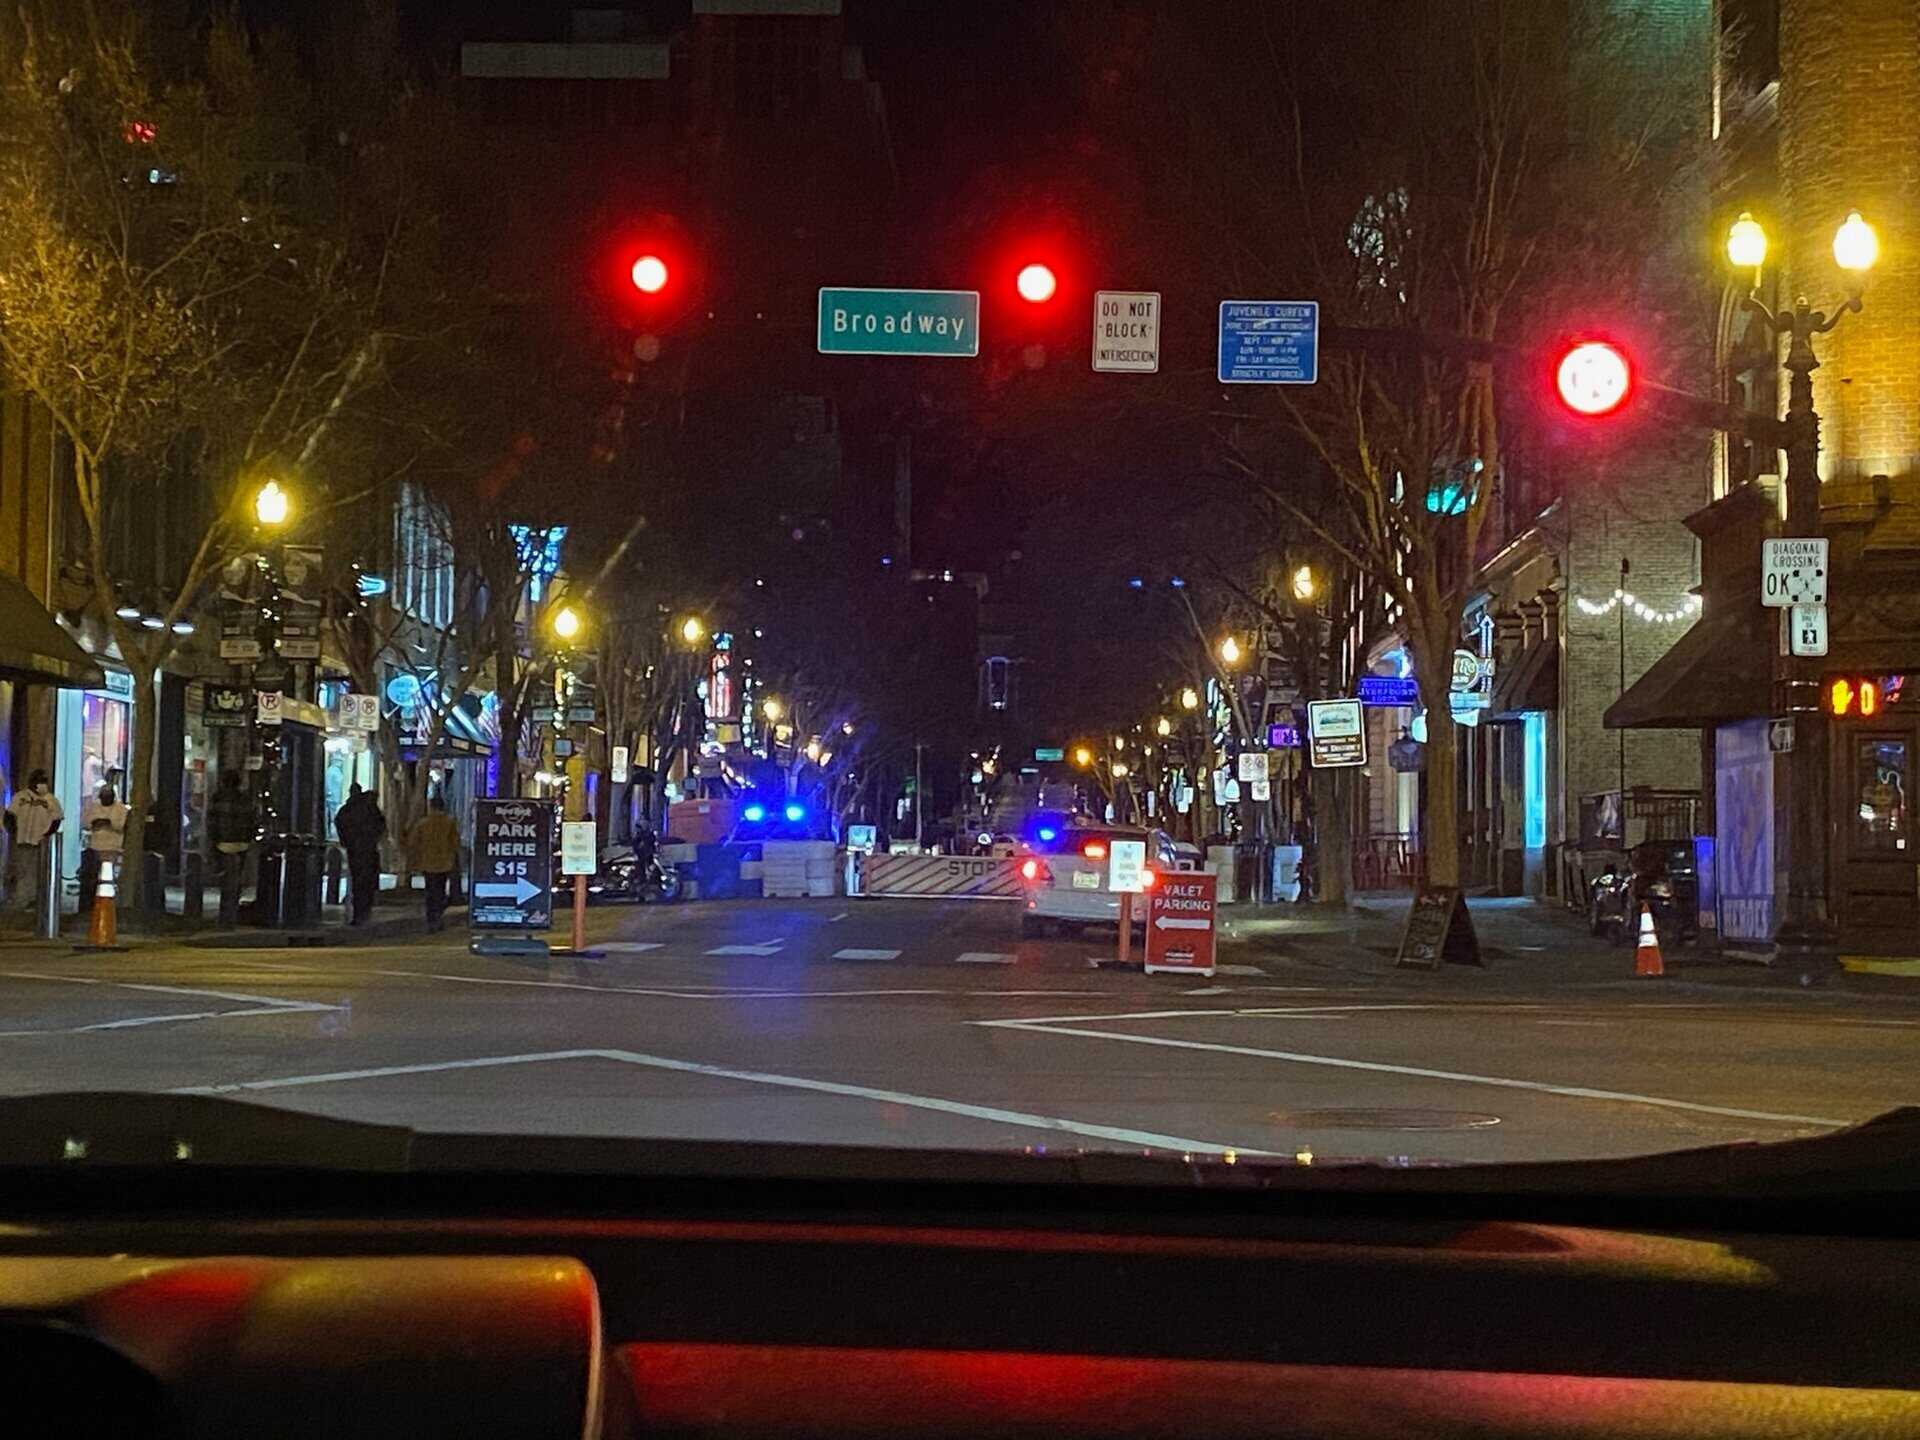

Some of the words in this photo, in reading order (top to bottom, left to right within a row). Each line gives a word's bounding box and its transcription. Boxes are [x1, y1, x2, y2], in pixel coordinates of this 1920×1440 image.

[1102, 302, 1119, 317] DO
[1129, 302, 1152, 317] NOT
[1227, 306, 1271, 317] JUVENILE
[1274, 306, 1312, 318] CURFEW
[833, 309, 965, 341] Broadway
[1105, 323, 1148, 338] BLOCK
[1096, 350, 1157, 362] INTERSECTION
[1772, 542, 1821, 555] DIAGONAL
[1772, 555, 1820, 568] CROSSING
[1767, 573, 1790, 596] OK
[487, 823, 537, 837] PARK
[487, 842, 537, 857] HERE
[494, 861, 528, 876] $15
[949, 861, 996, 877] STOP
[1162, 884, 1205, 897] VALET
[1154, 898, 1211, 912] PARKING
